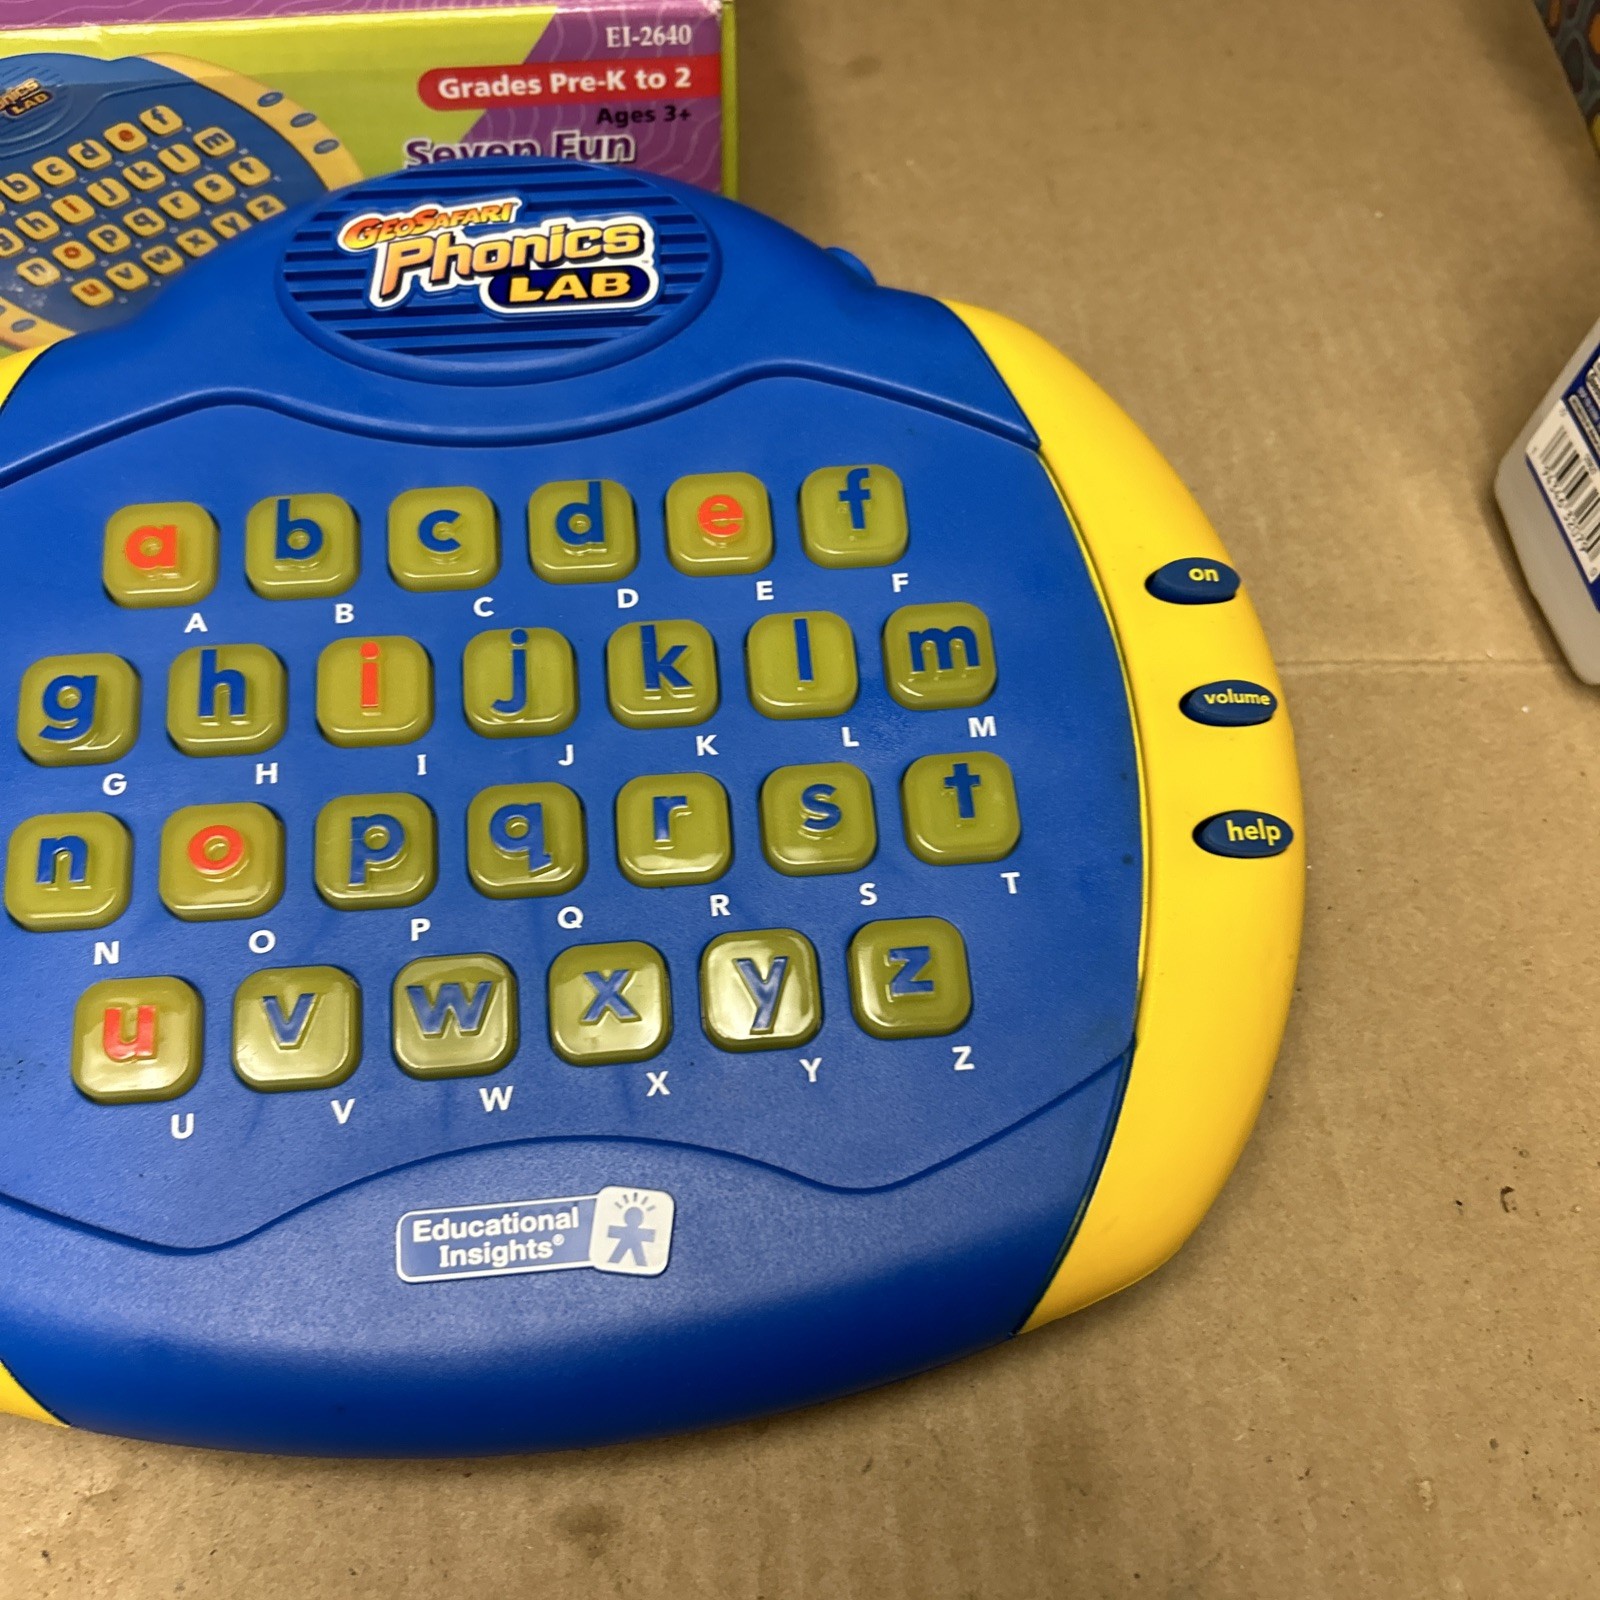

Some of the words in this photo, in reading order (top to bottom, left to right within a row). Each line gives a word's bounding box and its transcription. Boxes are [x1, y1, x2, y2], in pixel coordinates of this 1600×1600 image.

[606, 24, 692, 48] EI-2640
[438, 74, 541, 100] Grades
[550, 70, 626, 94] Pre-K
[635, 68, 666, 89] to
[675, 67, 692, 88] 2
[597, 108, 655, 128] Ages
[664, 105, 691, 123] 3+
[46, 163, 65, 177] c
[81, 141, 102, 160] d
[151, 106, 169, 126] f
[552, 130, 636, 164] Fun
[22, 216, 49, 232] h
[129, 166, 158, 181] k
[201, 132, 229, 151] m
[98, 229, 118, 248] p
[132, 212, 158, 228] q
[204, 179, 222, 192] s
[239, 159, 256, 175] t
[147, 248, 172, 266] w
[184, 234, 208, 251] x
[255, 200, 276, 215] z
[380, 222, 645, 300] Phonics
[508, 271, 631, 303] LAB
[125, 525, 178, 570] a
[274, 498, 323, 561] b
[418, 508, 462, 554] c
[555, 481, 605, 546] d
[697, 494, 744, 537] e
[838, 467, 871, 530] f
[184, 611, 208, 634] A
[334, 603, 355, 624] B
[473, 597, 495, 618] C
[617, 588, 639, 609] D
[756, 580, 775, 601] E
[891, 573, 909, 593] F
[1188, 567, 1220, 583] on
[38, 673, 98, 743] g
[197, 648, 247, 718] h
[359, 641, 380, 708] i
[490, 628, 529, 717] j
[640, 624, 693, 691] k
[793, 617, 815, 682] l
[907, 624, 981, 674] m
[1204, 688, 1271, 706] volume
[102, 772, 128, 796] G
[254, 762, 279, 785] H
[416, 754, 427, 777] I
[558, 744, 575, 767] J
[695, 735, 720, 757] K
[841, 726, 860, 748] L
[967, 716, 997, 738] M
[36, 834, 88, 886] n
[187, 824, 244, 872] o
[347, 812, 406, 887] p
[489, 802, 550, 873] q
[652, 794, 688, 845] r
[800, 783, 842, 832] s
[944, 762, 981, 820] t
[1225, 818, 1282, 846] help
[93, 940, 120, 966] N
[248, 929, 277, 954] O
[410, 918, 431, 942] P
[557, 906, 584, 930] Q
[710, 894, 731, 917] R
[858, 883, 878, 907] S
[999, 872, 1021, 895] T
[102, 1004, 157, 1063] u
[261, 991, 317, 1050] v
[405, 980, 499, 1040] w
[581, 967, 641, 1026] x
[732, 955, 788, 1035] y
[887, 945, 935, 997] z
[170, 1114, 195, 1139] U
[330, 1099, 355, 1124] V
[479, 1085, 514, 1112] W
[645, 1071, 671, 1096] X
[799, 1057, 823, 1082] Y
[952, 1045, 975, 1071] Z
[412, 1206, 580, 1244] Educational
